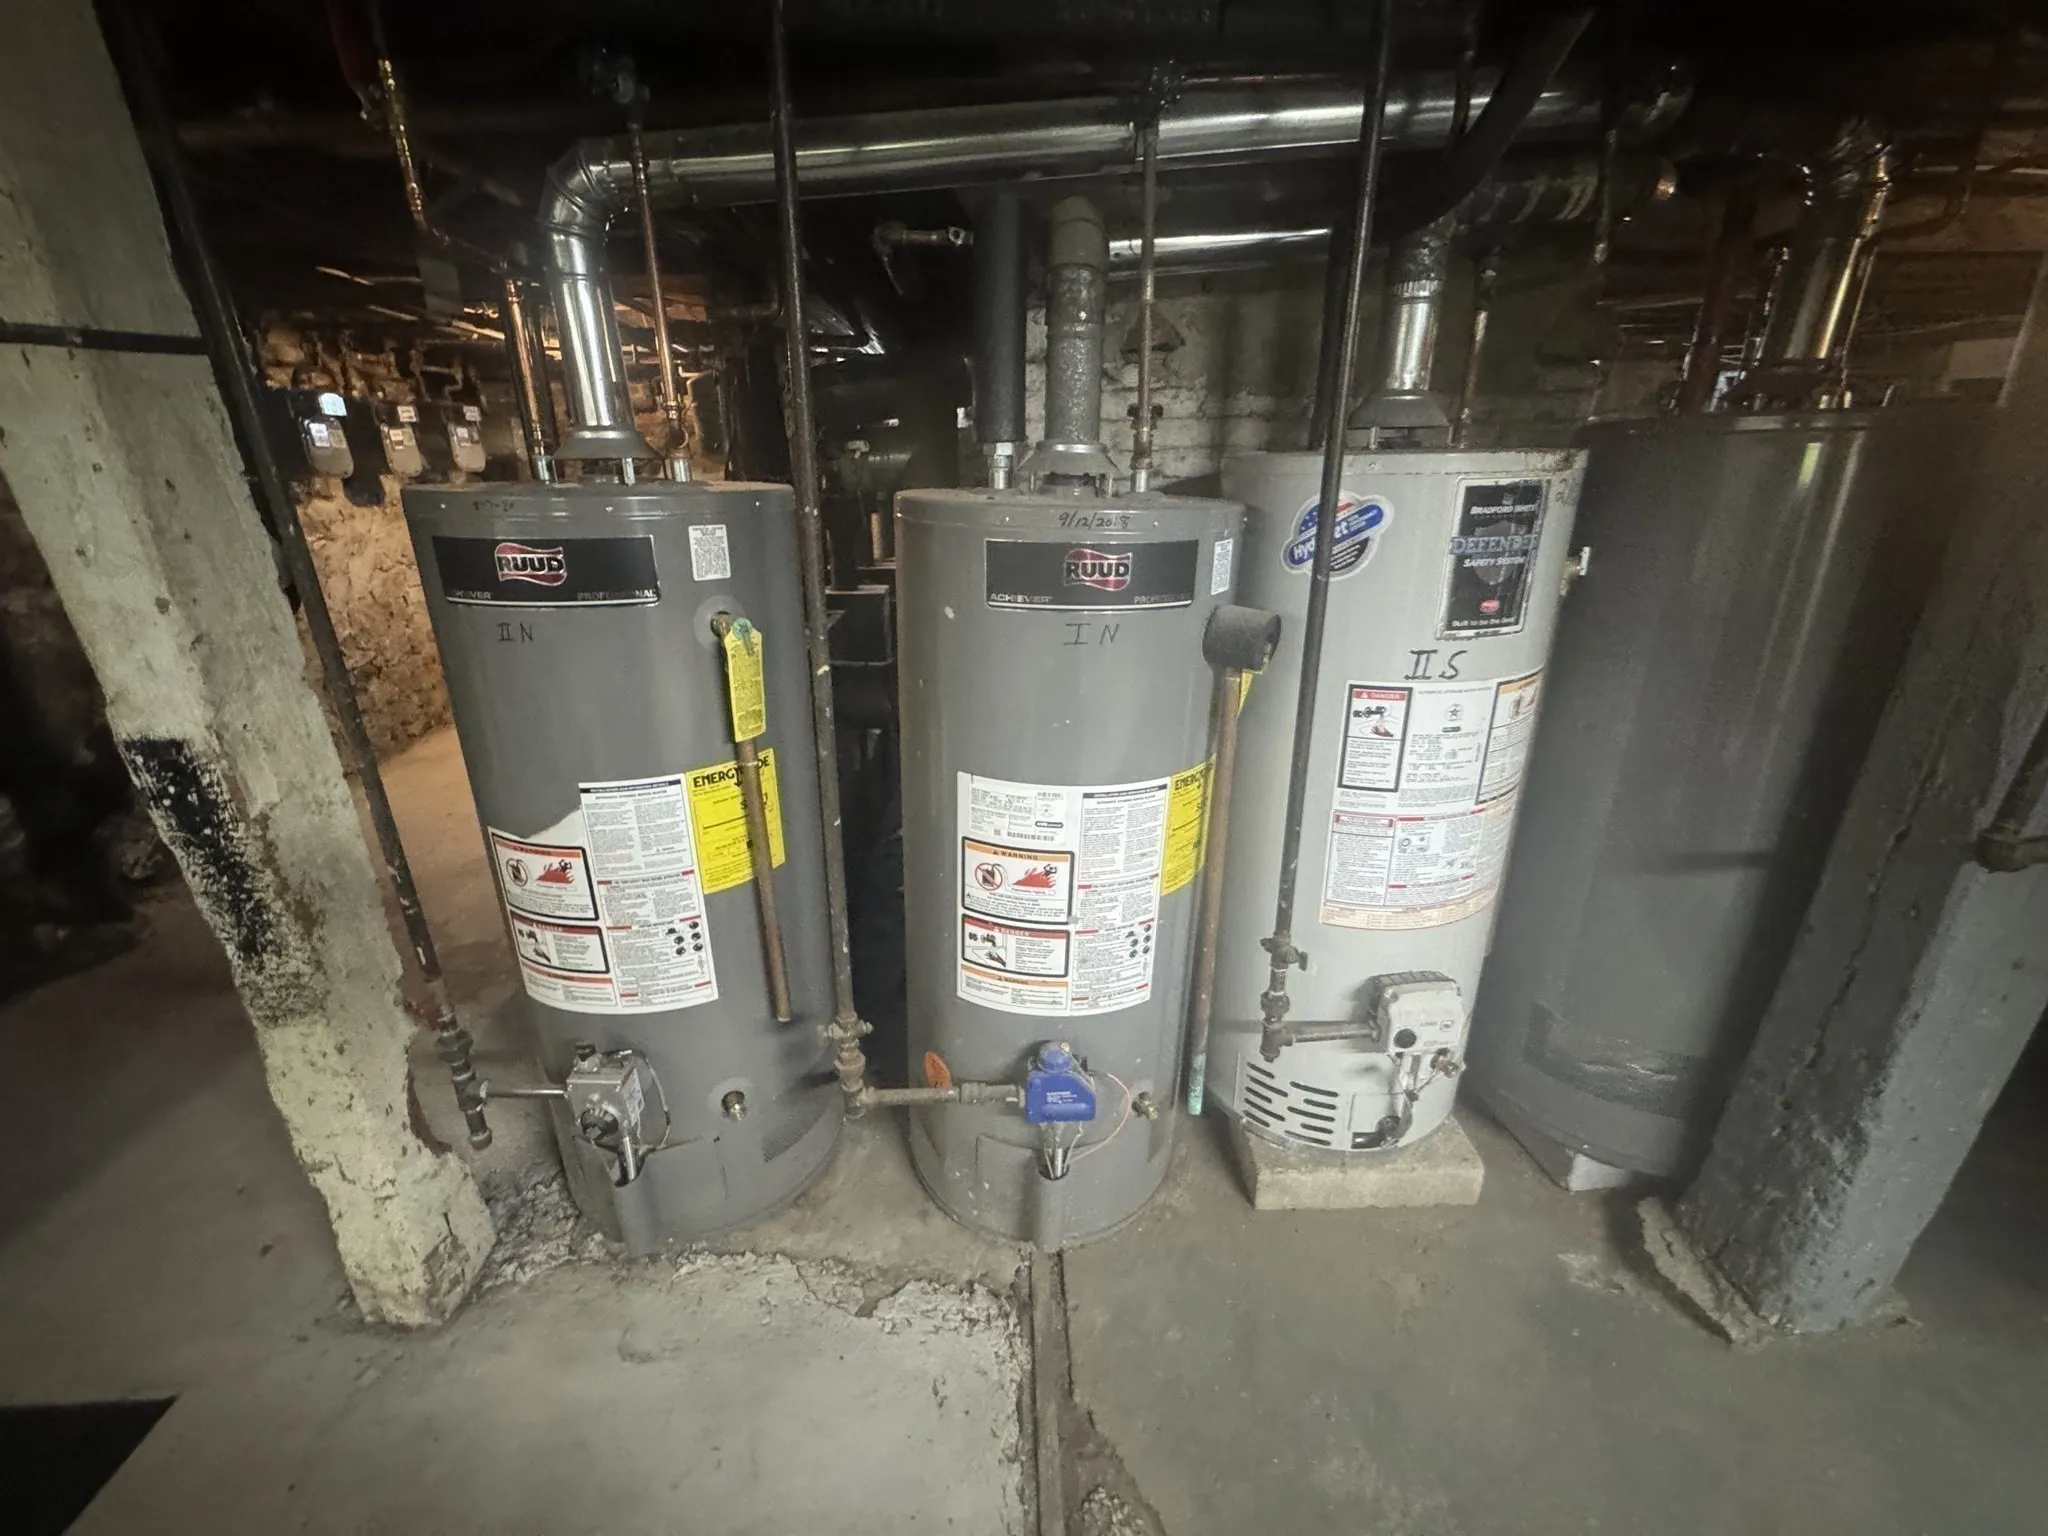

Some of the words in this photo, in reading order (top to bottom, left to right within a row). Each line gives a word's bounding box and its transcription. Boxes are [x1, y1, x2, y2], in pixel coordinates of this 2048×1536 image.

[1058, 510, 1131, 531] 9/12/2018
[1293, 521, 1348, 560] Hydet
[497, 555, 565, 574] RUUD
[1065, 561, 1131, 579] RUUD
[520, 621, 533, 642] N
[1099, 623, 1121, 644] N
[1000, 850, 1039, 861] WARNING
